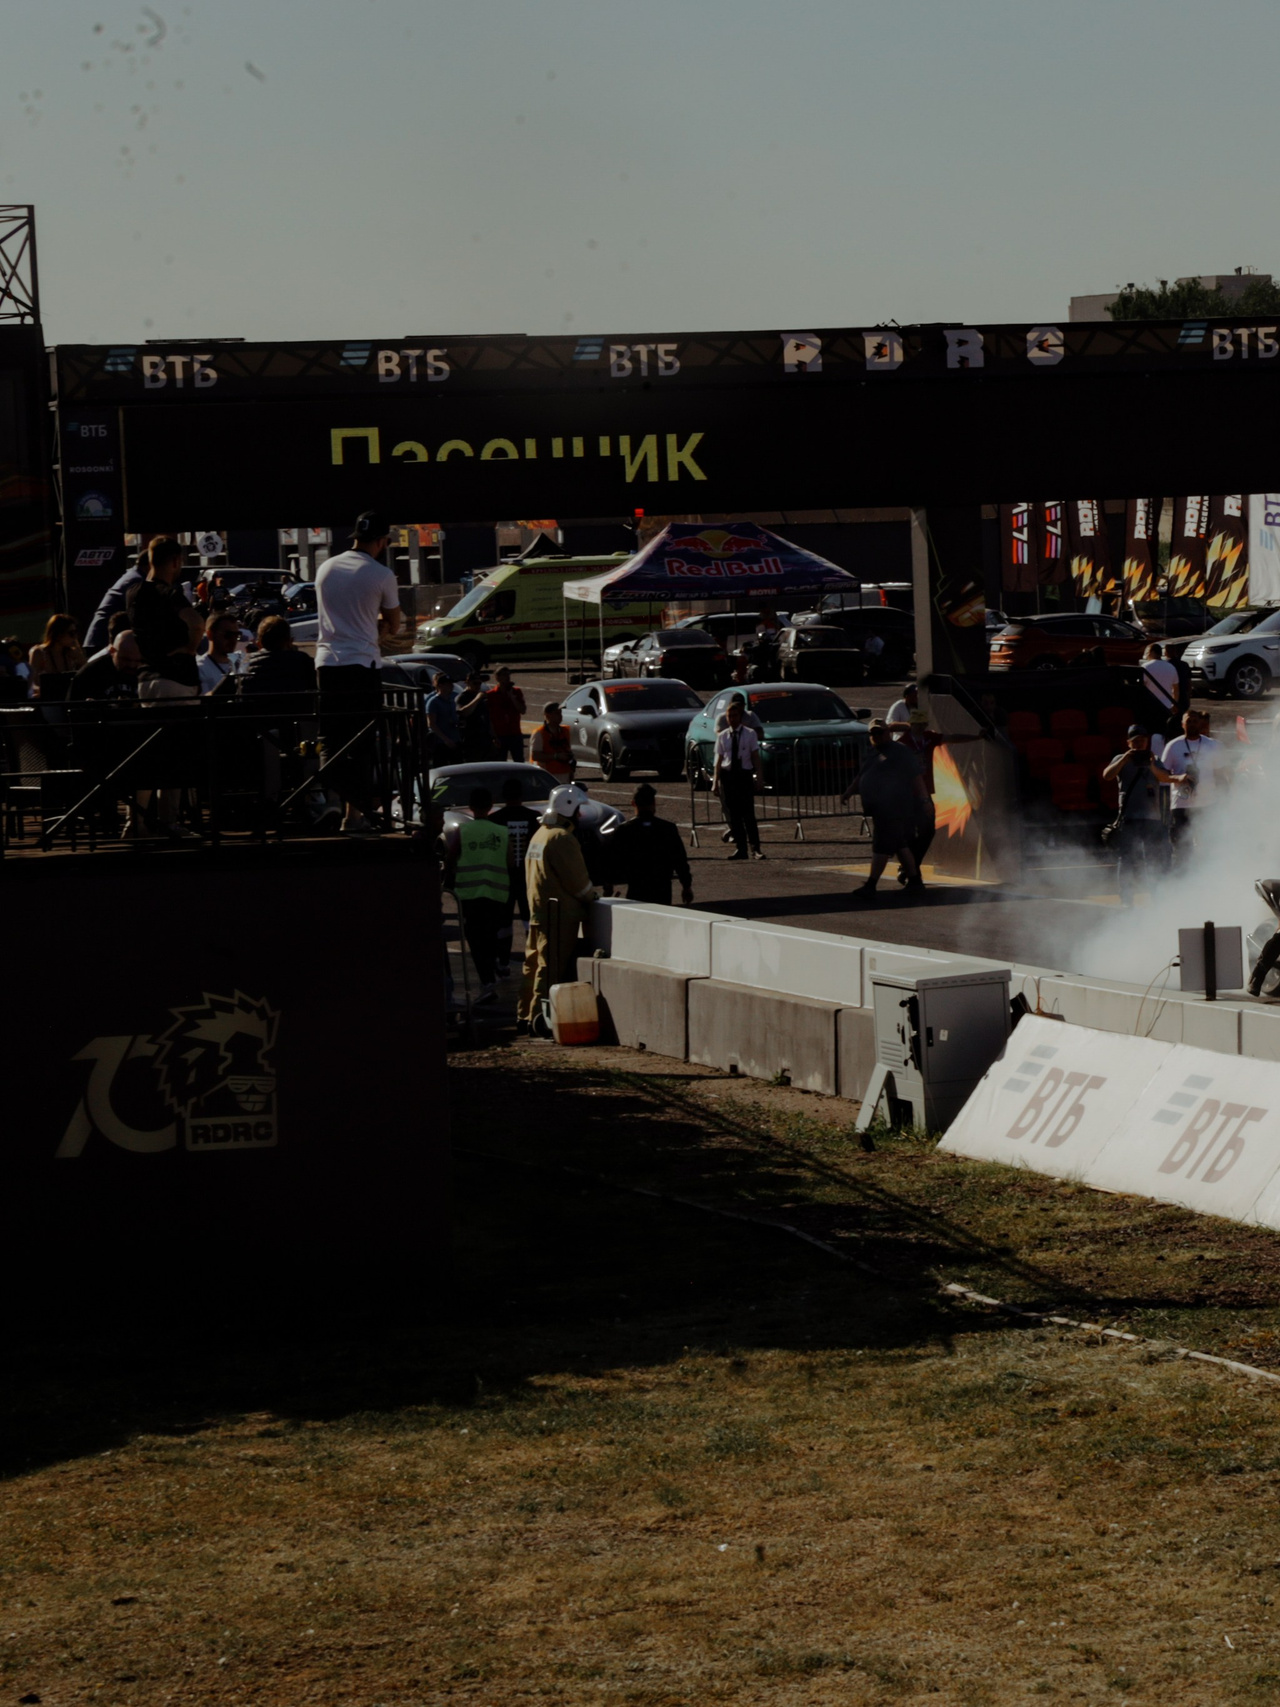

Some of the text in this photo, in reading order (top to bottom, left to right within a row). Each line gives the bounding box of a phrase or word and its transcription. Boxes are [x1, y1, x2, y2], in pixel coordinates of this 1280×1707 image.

[609, 343, 681, 378] ВТБ
[1212, 326, 1280, 361] ВТБ
[142, 354, 218, 389] ВТБ
[377, 348, 451, 383] ВТБ
[80, 425, 107, 437] ВТБ
[1134, 498, 1149, 539] RDR
[1184, 496, 1202, 537] RDR
[664, 556, 786, 577] Red Bull
[750, 588, 778, 596] MOTUL
[530, 620, 578, 629] МЕДИЦИНКАЯ
[1006, 1067, 1107, 1149] ВТБ
[190, 1121, 274, 1145] RDRC
[1157, 1098, 1268, 1184] ВТБ
